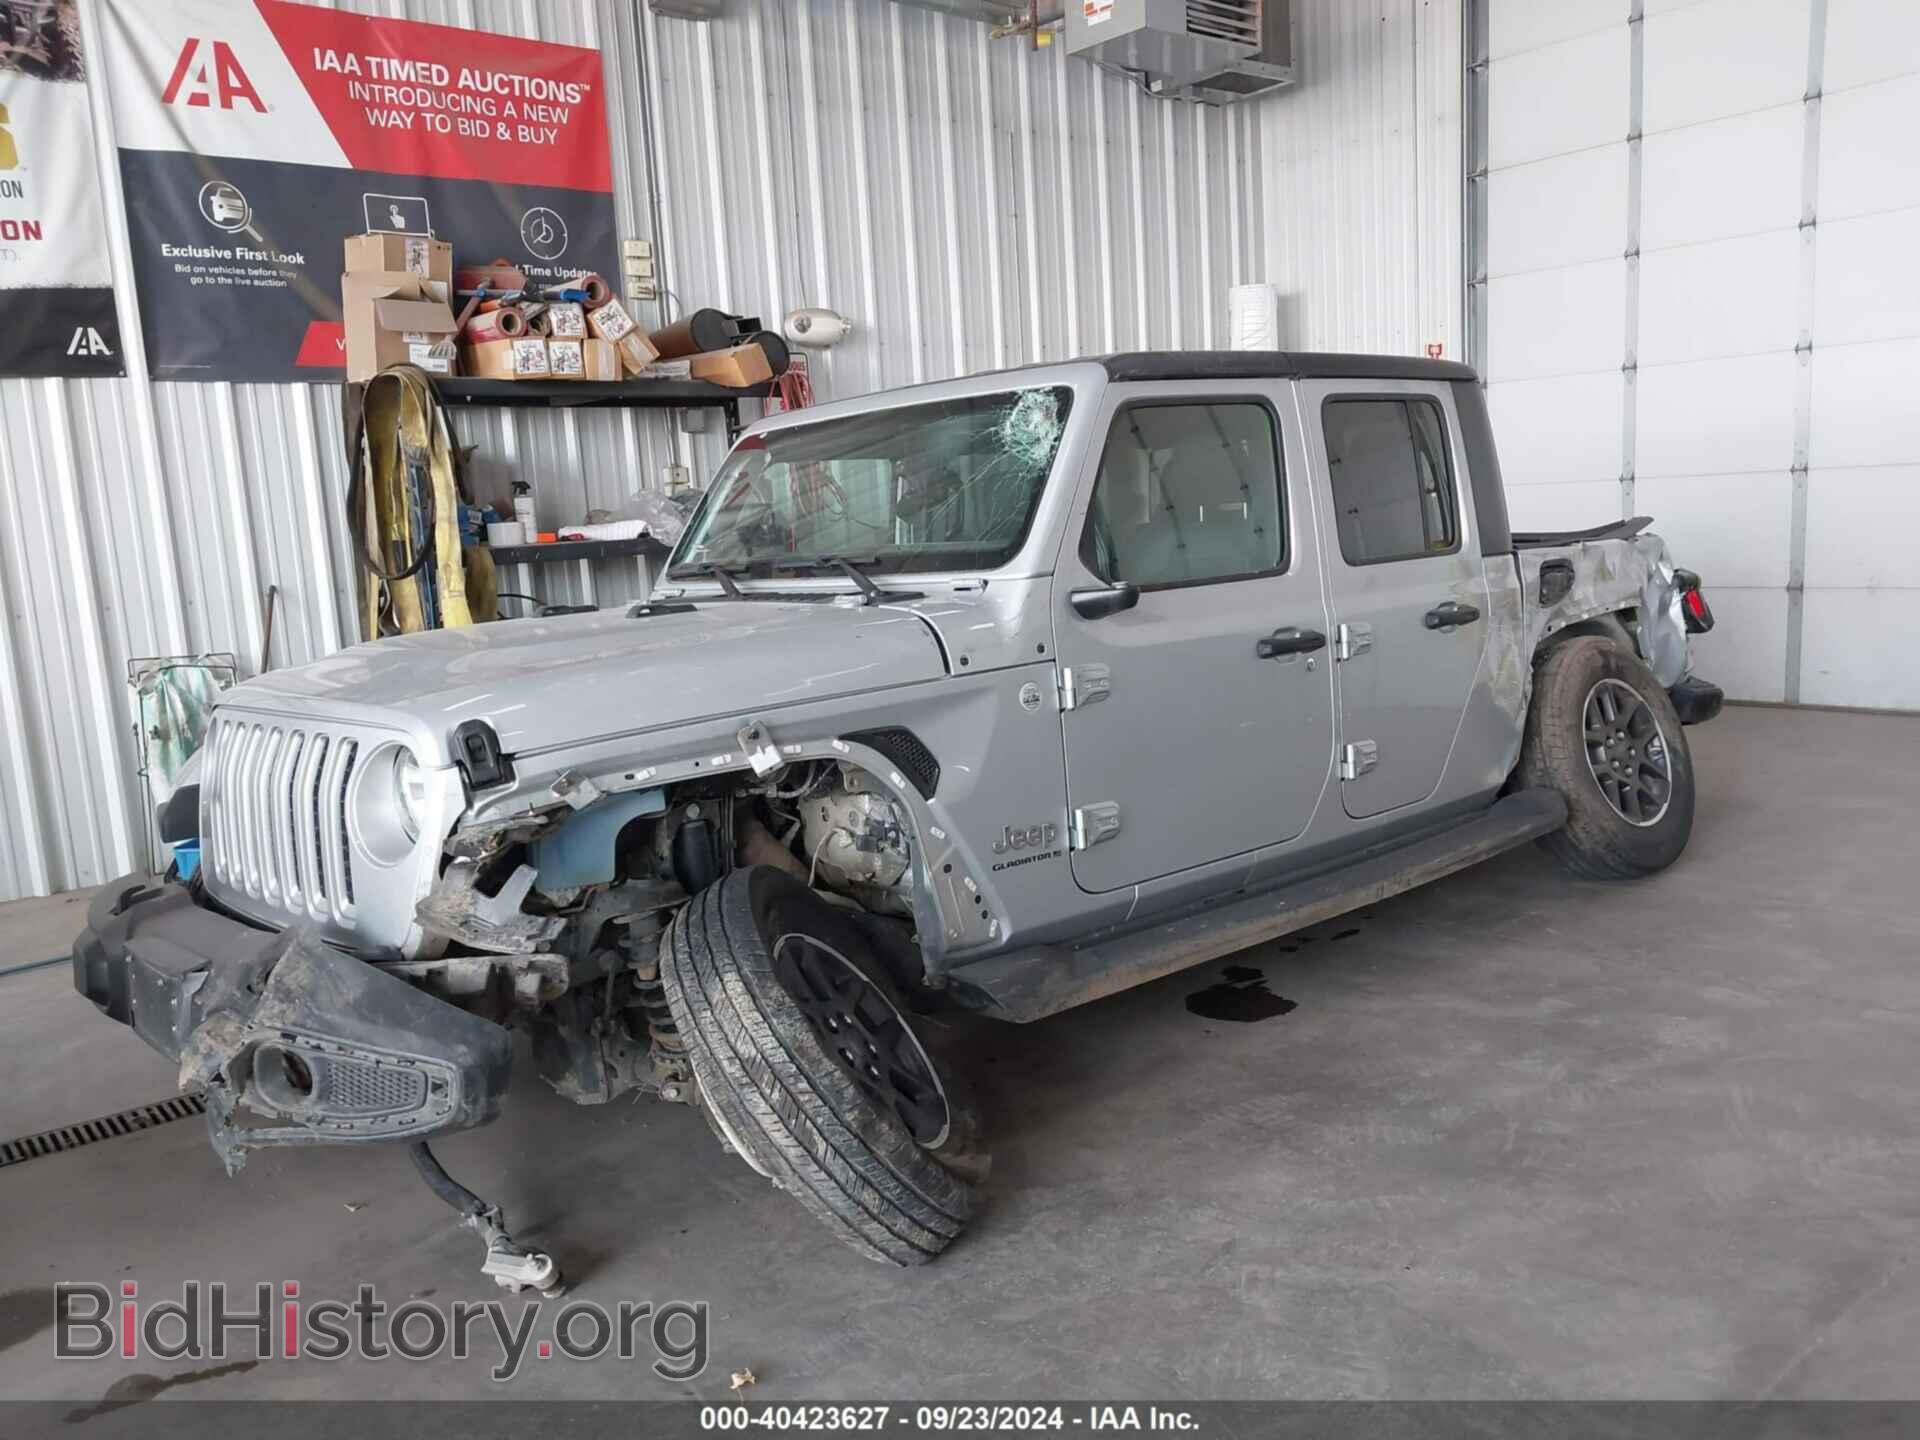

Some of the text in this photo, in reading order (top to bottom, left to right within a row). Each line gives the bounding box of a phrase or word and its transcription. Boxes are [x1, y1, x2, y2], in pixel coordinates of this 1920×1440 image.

[313, 47, 362, 77] IAA
[365, 56, 449, 86] TIMED
[349, 80, 569, 125] INTRODUCING A NEW
[365, 107, 558, 145] WAY TO BID & BUY
[161, 243, 305, 264] Exclusive First Look
[174, 264, 191, 273] Bid
[193, 265, 206, 273] on
[208, 265, 246, 276] vehicles
[247, 267, 278, 277] before
[190, 276, 288, 288] go to the live auction
[992, 824, 1057, 854] Jeep
